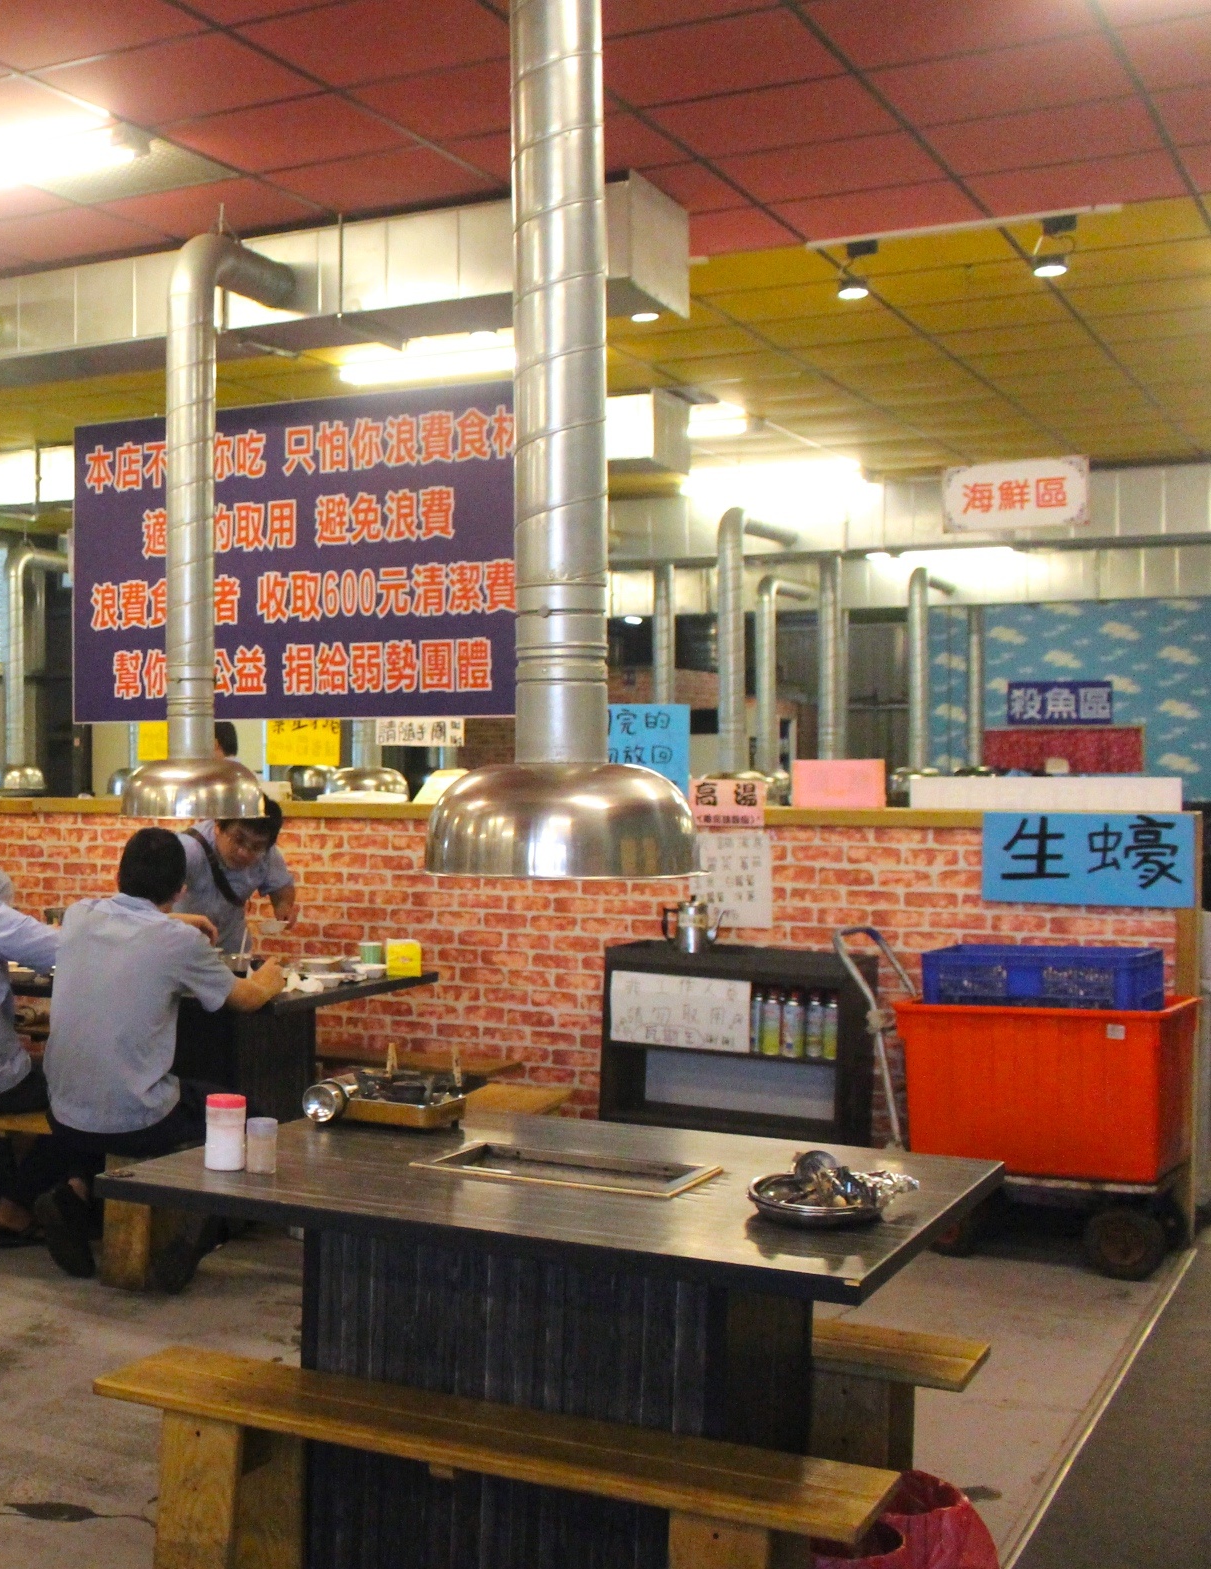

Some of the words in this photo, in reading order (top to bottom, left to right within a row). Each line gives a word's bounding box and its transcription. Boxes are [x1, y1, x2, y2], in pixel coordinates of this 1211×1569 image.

[85, 429, 266, 493] 本店不你吃
[282, 404, 515, 477] 只怕你浪費食材
[141, 499, 297, 559] 適的取用
[315, 485, 455, 548] 避免浪費
[962, 476, 1067, 514] 海鮮區
[91, 573, 241, 631] 浪費食者
[257, 559, 515, 623] 收取600元清潔費
[113, 644, 267, 700] 幫你公益
[282, 636, 492, 696] 捐給弱勢團體
[608, 709, 670, 735] 完的
[1010, 686, 1112, 721] 殺魚區
[1001, 815, 1183, 889] 生蠔
